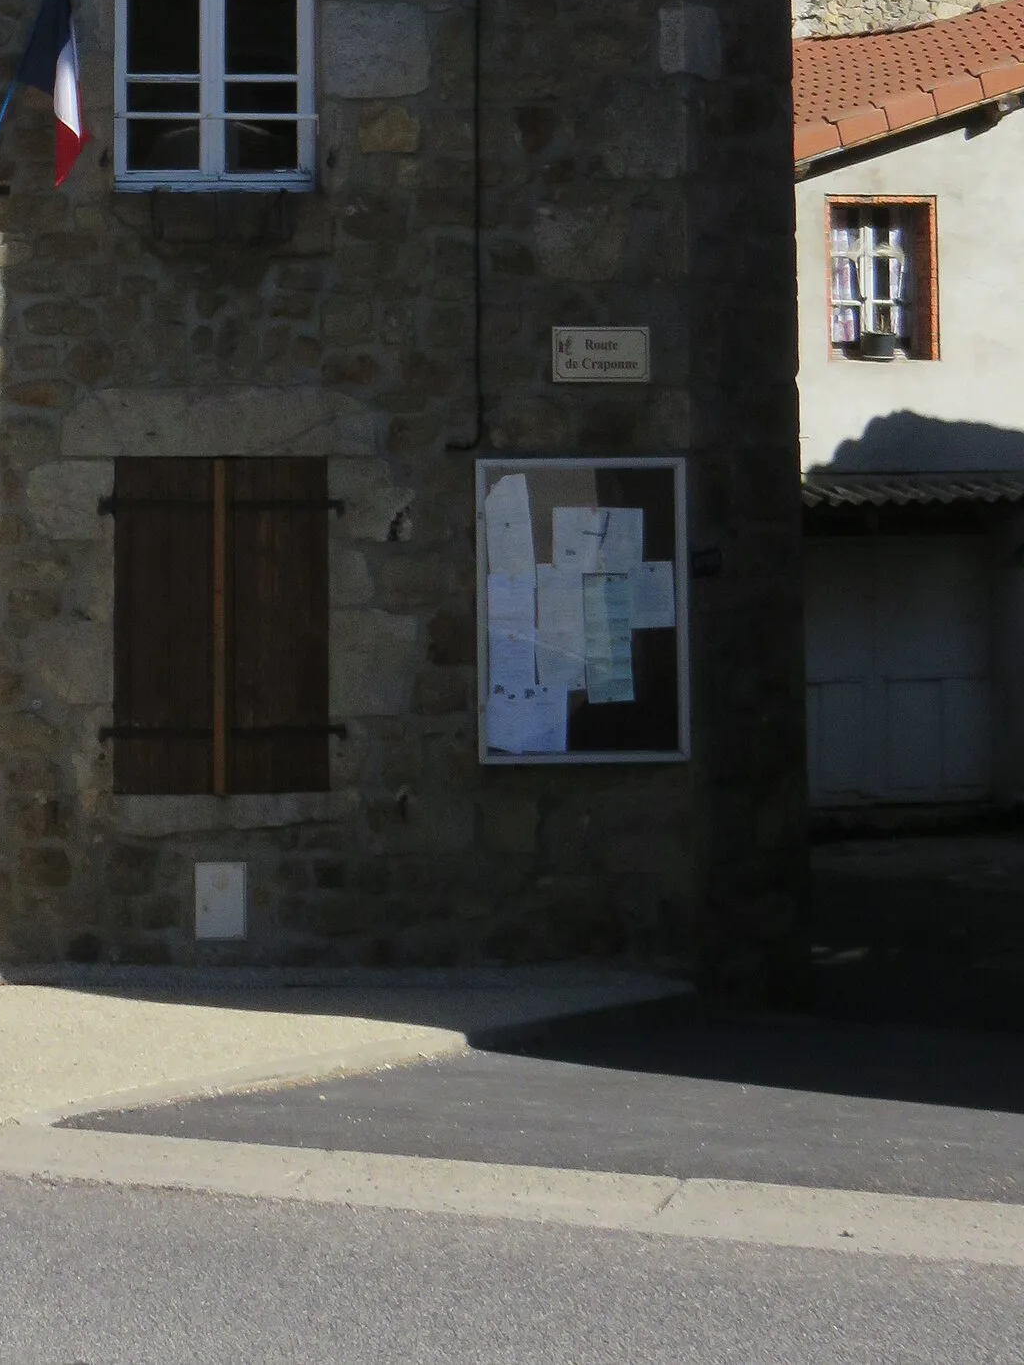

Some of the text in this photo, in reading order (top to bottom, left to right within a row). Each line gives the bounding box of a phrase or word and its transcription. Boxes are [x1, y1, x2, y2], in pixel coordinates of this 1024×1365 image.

[585, 338, 618, 351] Route
[564, 357, 638, 372] de Craponne
